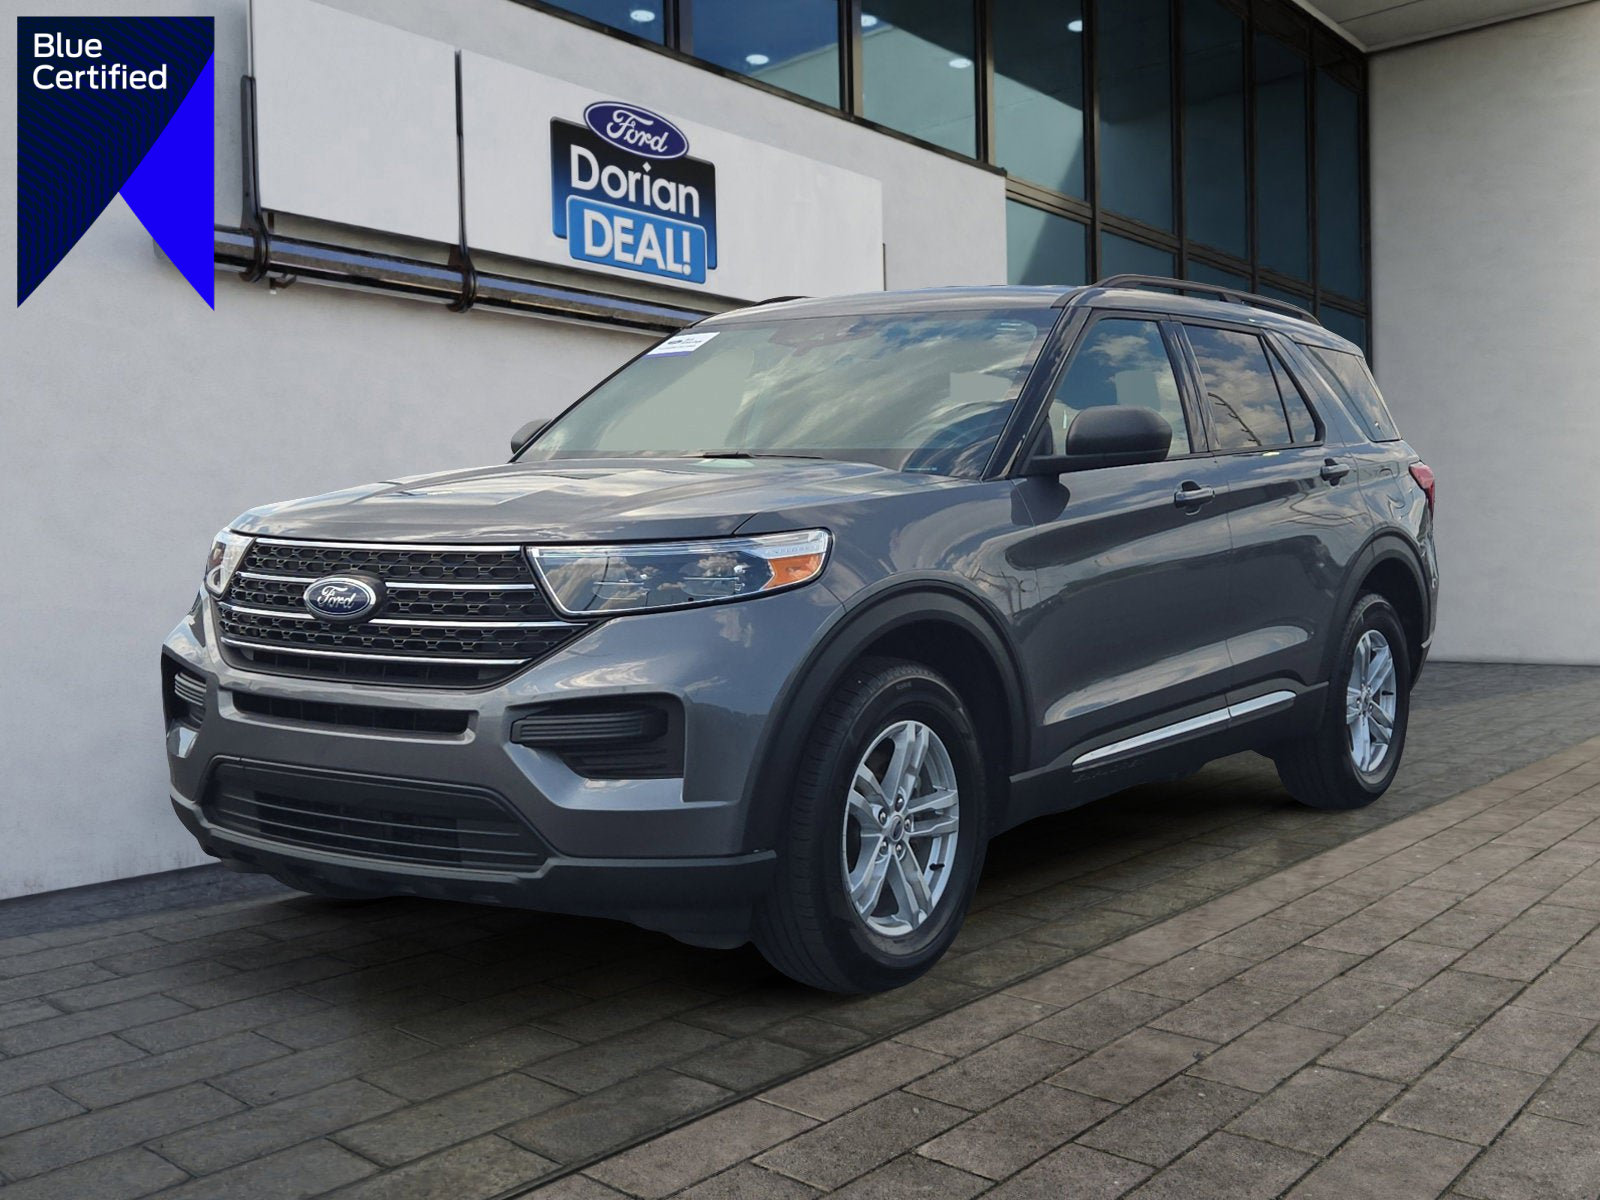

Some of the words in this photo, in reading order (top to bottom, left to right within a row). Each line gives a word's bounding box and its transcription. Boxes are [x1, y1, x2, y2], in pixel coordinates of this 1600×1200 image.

[606, 109, 669, 153] Ford
[570, 143, 700, 219] Dorian
[583, 208, 692, 276] DEAL!
[317, 585, 357, 609] Ford
